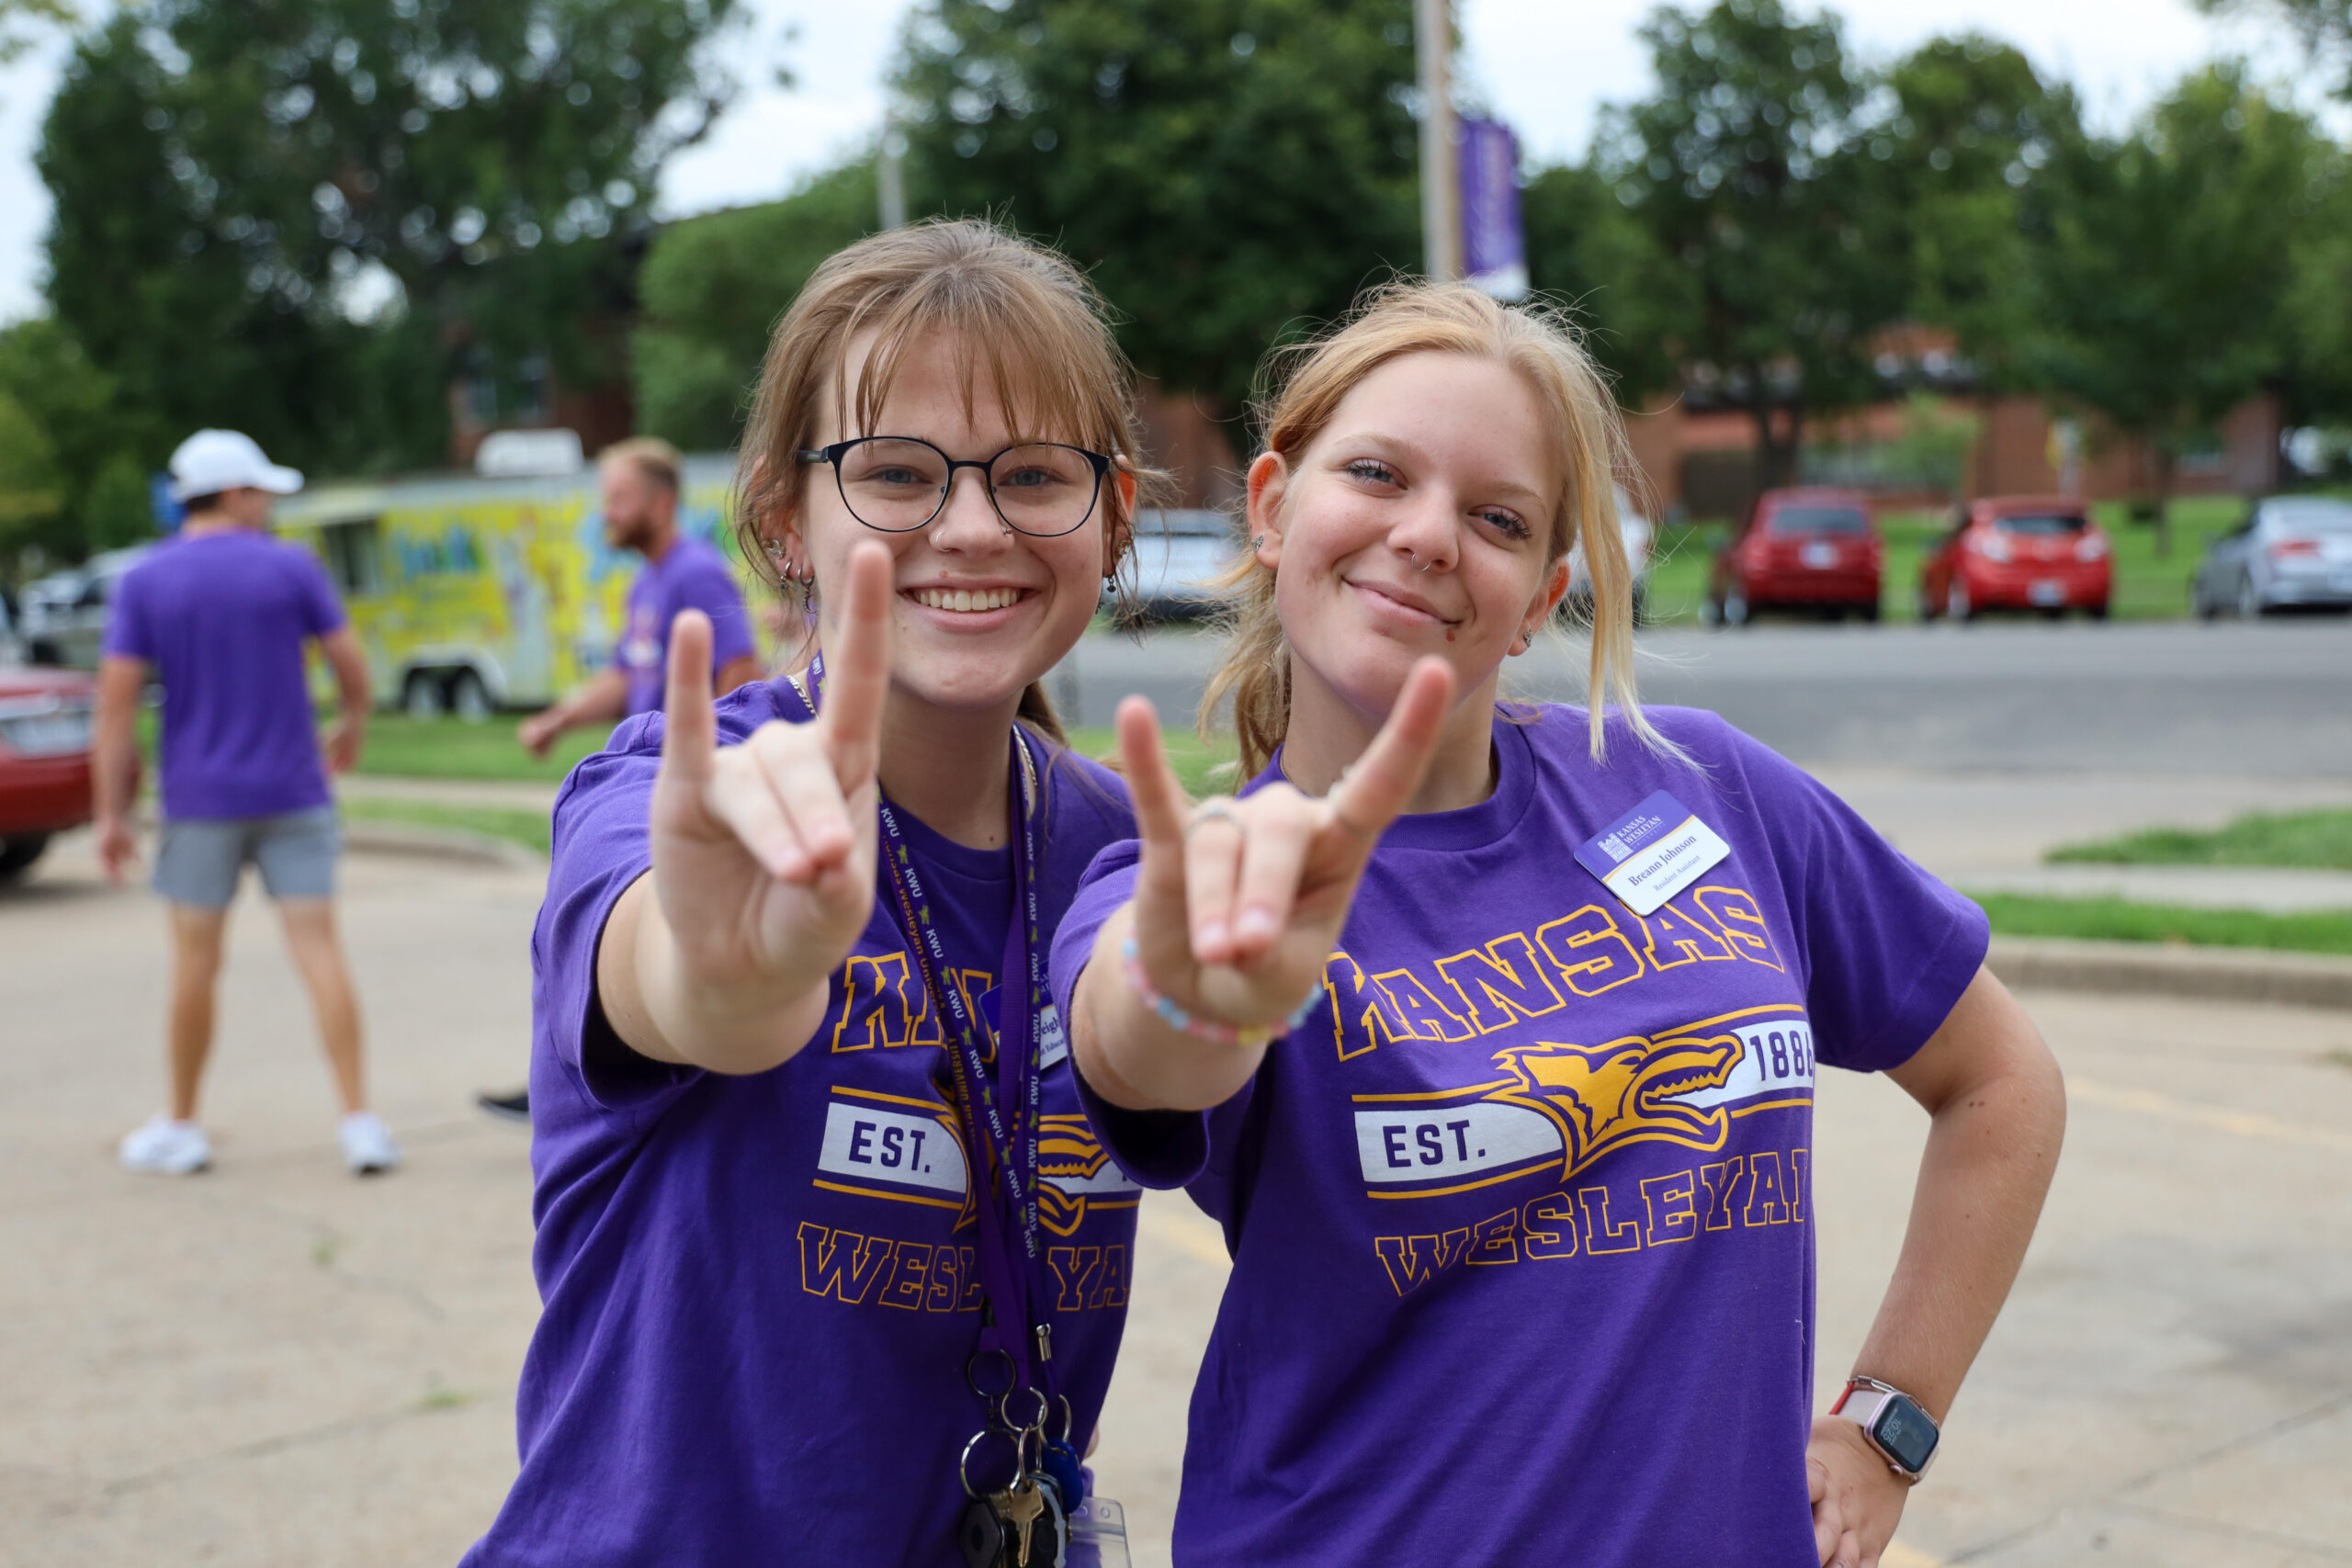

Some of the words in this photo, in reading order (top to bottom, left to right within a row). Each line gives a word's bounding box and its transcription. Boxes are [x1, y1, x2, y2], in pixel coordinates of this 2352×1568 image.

[881, 807, 899, 838] KWU
[1617, 816, 1645, 838] KANSAS
[1623, 816, 1661, 844] WESLEYAN
[1628, 861, 1663, 886] Breann
[1658, 836, 1697, 865] Johnson
[905, 868, 922, 898] KWU
[926, 929, 944, 958] KWU
[1031, 953, 1039, 982] KWU
[1323, 886, 1784, 1062] KANSAS
[948, 989, 965, 1019] KWU
[969, 1049, 986, 1078] KWU
[1030, 1076, 1039, 1105] KWU
[989, 1109, 1003, 1139] KWU
[848, 1120, 931, 1173] EST.
[1028, 1138, 1037, 1168] KWU
[1383, 1120, 1487, 1168] EST.
[1007, 1169, 1022, 1199] KWU
[1028, 1201, 1037, 1232] KWU
[1023, 1229, 1036, 1258] KWU
[797, 1221, 1129, 1312] WESLYA
